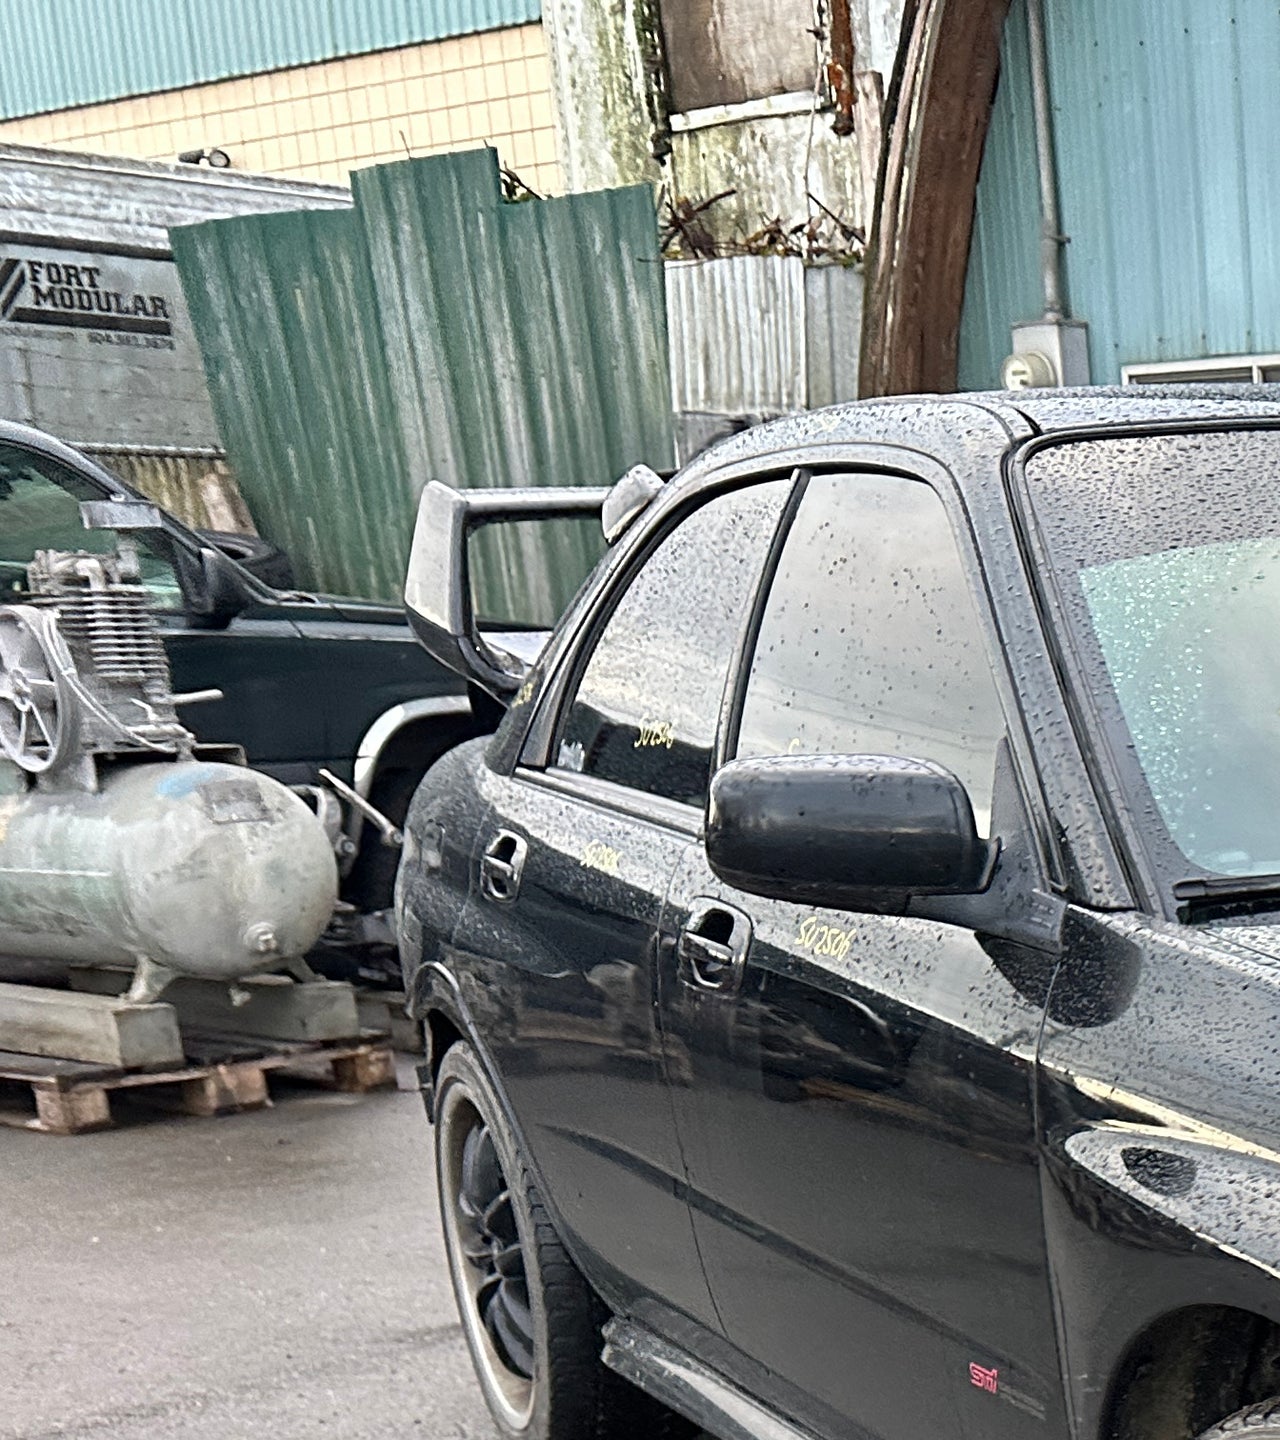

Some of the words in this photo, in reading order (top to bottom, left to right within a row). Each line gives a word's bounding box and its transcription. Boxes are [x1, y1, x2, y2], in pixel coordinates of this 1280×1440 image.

[27, 261, 100, 289] FORT
[30, 285, 171, 319] MODULAR
[794, 916, 857, 962] SU2506
